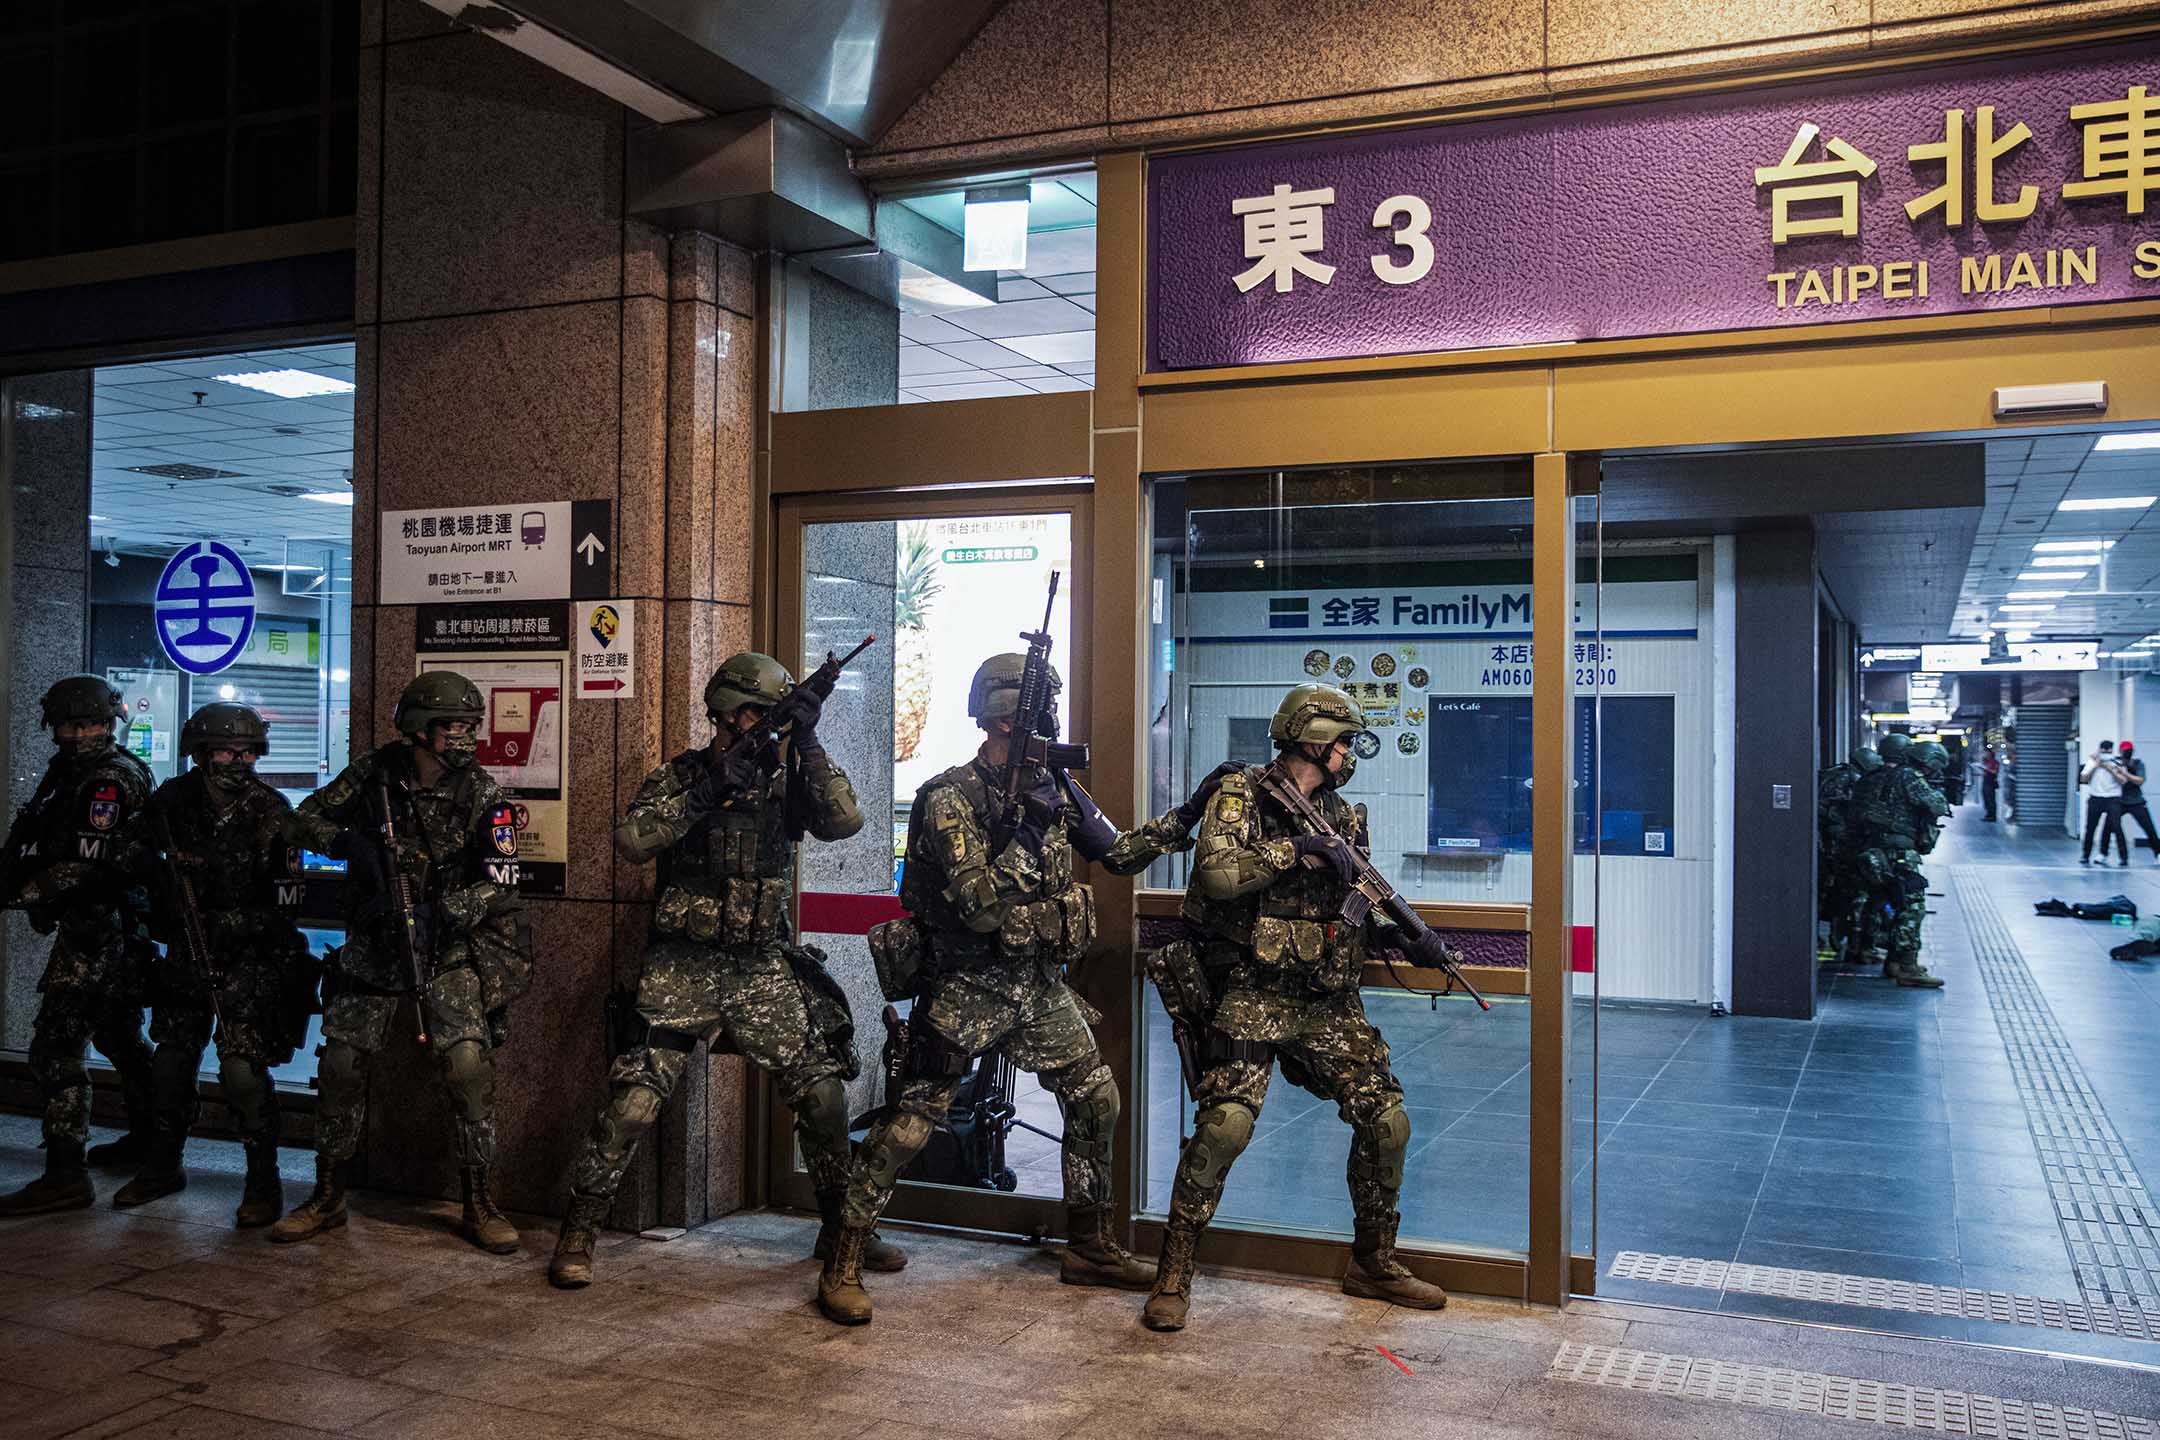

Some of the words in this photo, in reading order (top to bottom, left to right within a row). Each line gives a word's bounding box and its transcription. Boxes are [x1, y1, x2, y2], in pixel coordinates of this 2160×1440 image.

[1754, 84, 2160, 245] 台北車
[1231, 183, 1337, 293] 東
[1370, 194, 1435, 285] 3
[1767, 260, 1928, 309] TAIPEI
[1960, 246, 2097, 294] MAIN
[402, 513, 513, 539] 桃園機場捷運
[405, 544, 448, 557] Taoyuan
[450, 542, 486, 555] Airport
[488, 540, 513, 551] MRT
[428, 570, 518, 587] 請由地下一層進入
[443, 588, 456, 596] Use
[457, 587, 485, 596] Entrance
[1321, 596, 1380, 627] 全家
[1392, 592, 1581, 630] FamilyM
[435, 617, 551, 635] 臺北車站周邊禁菸區
[581, 652, 629, 668] 防空避難
[1460, 702, 1481, 711] Café
